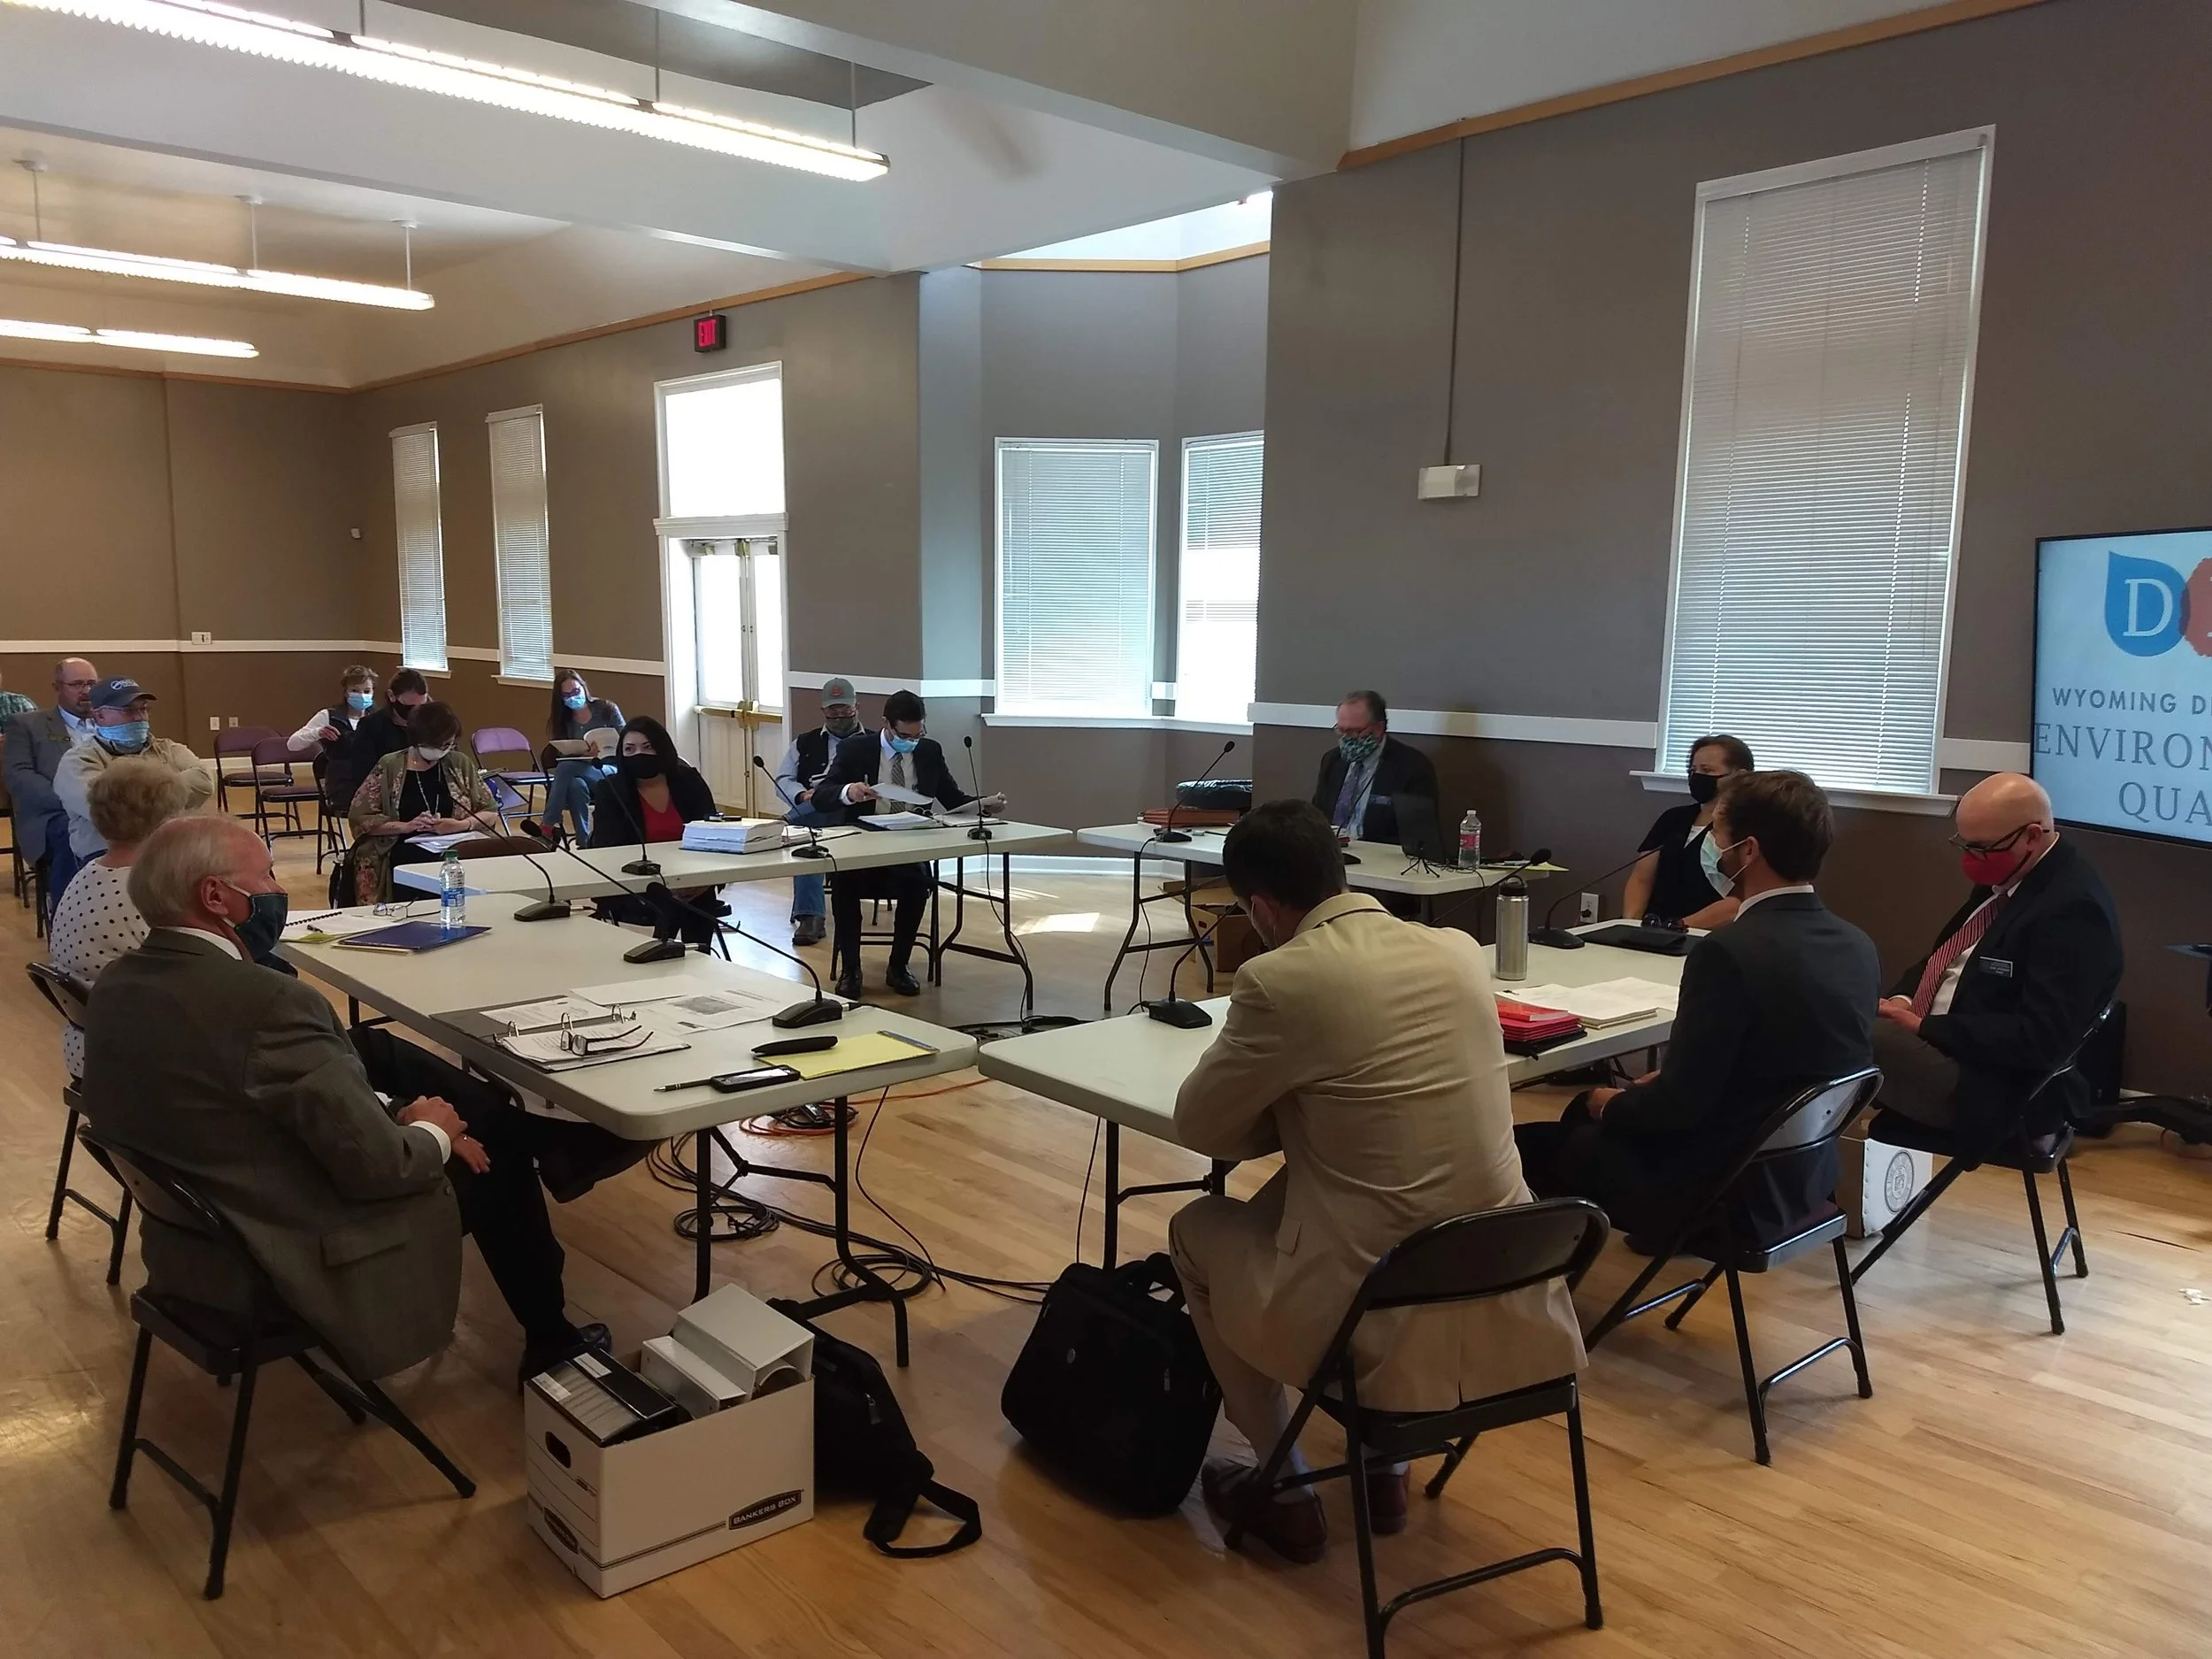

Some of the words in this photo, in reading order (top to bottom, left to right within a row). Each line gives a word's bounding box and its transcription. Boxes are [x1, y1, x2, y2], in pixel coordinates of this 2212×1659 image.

[2052, 687, 2177, 714] WYOMING
[2191, 695, 2212, 716] D
[2118, 781, 2212, 826] QUA
[733, 1503, 776, 1525] BANKERS
[778, 1495, 796, 1508] BOX
